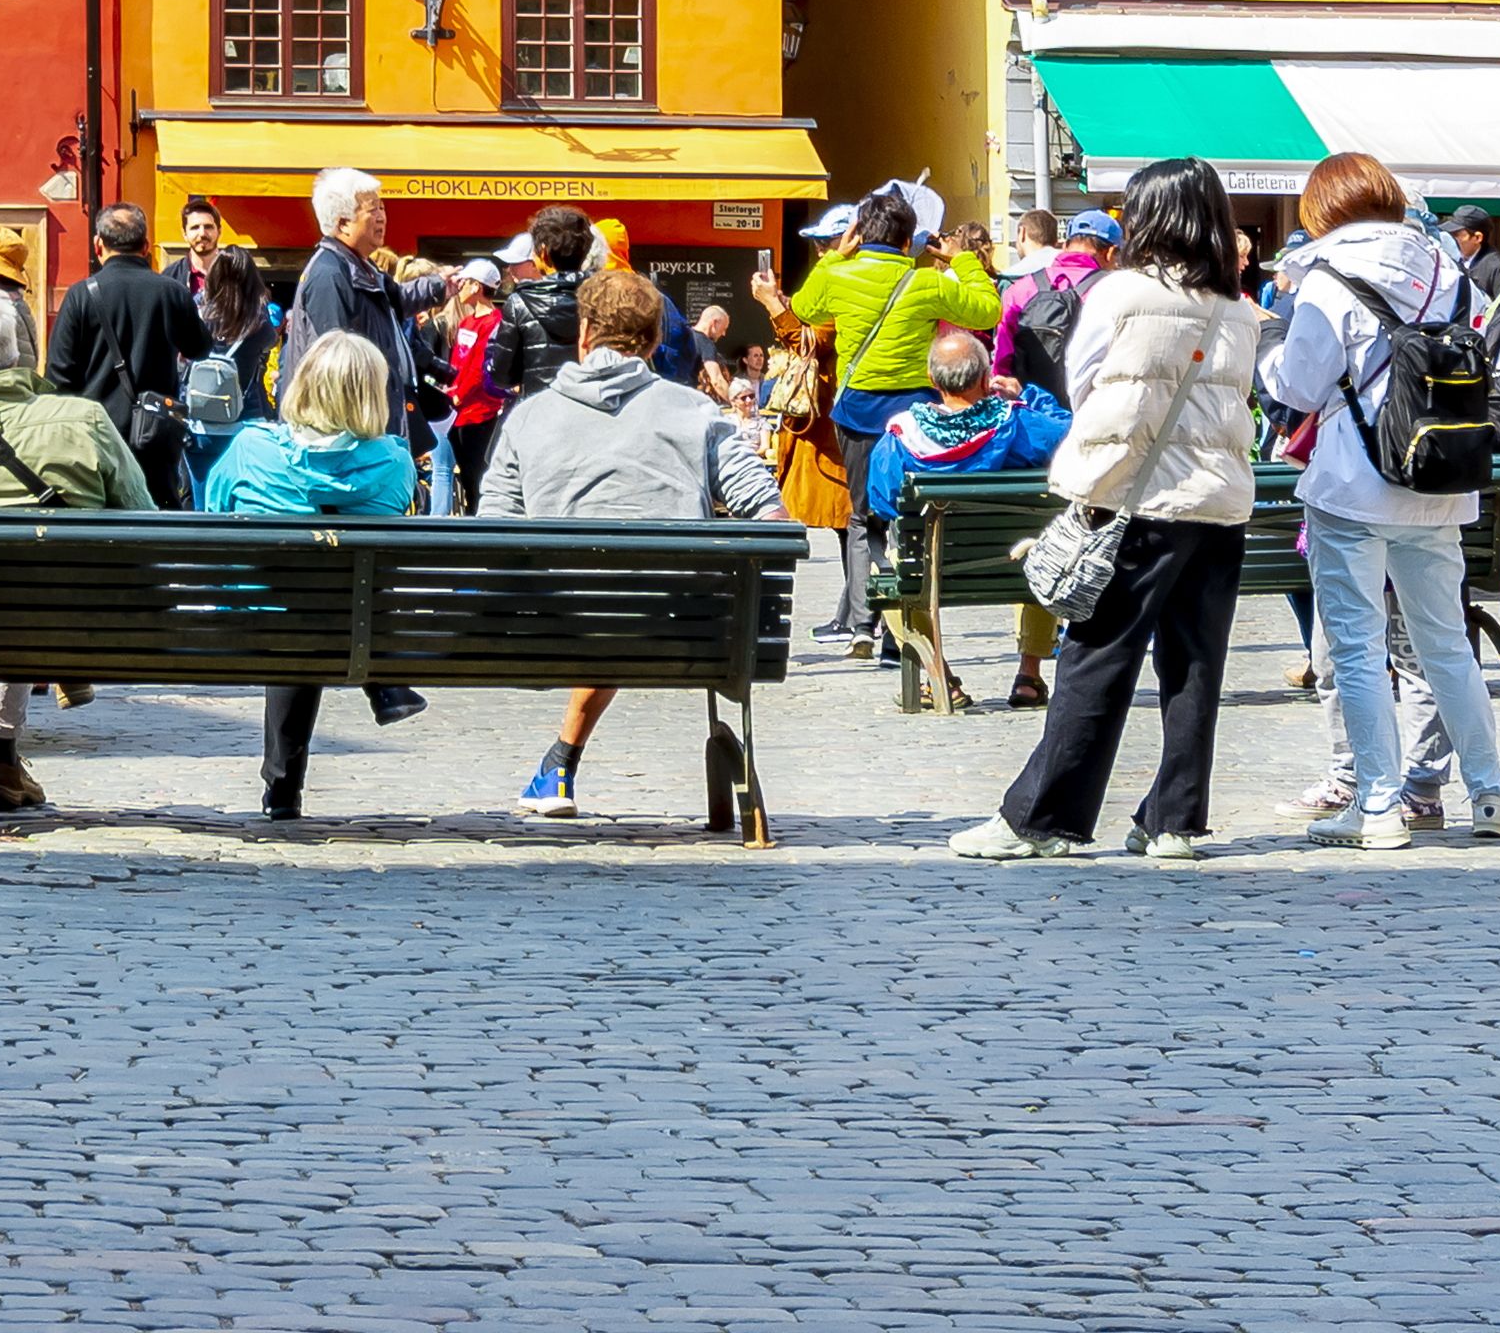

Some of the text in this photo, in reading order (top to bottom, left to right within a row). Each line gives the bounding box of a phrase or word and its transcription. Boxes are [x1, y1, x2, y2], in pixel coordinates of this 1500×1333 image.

[1228, 172, 1296, 189] Caffeteria
[719, 204, 761, 215] Stortorget
[650, 262, 716, 275] DRYCKER
